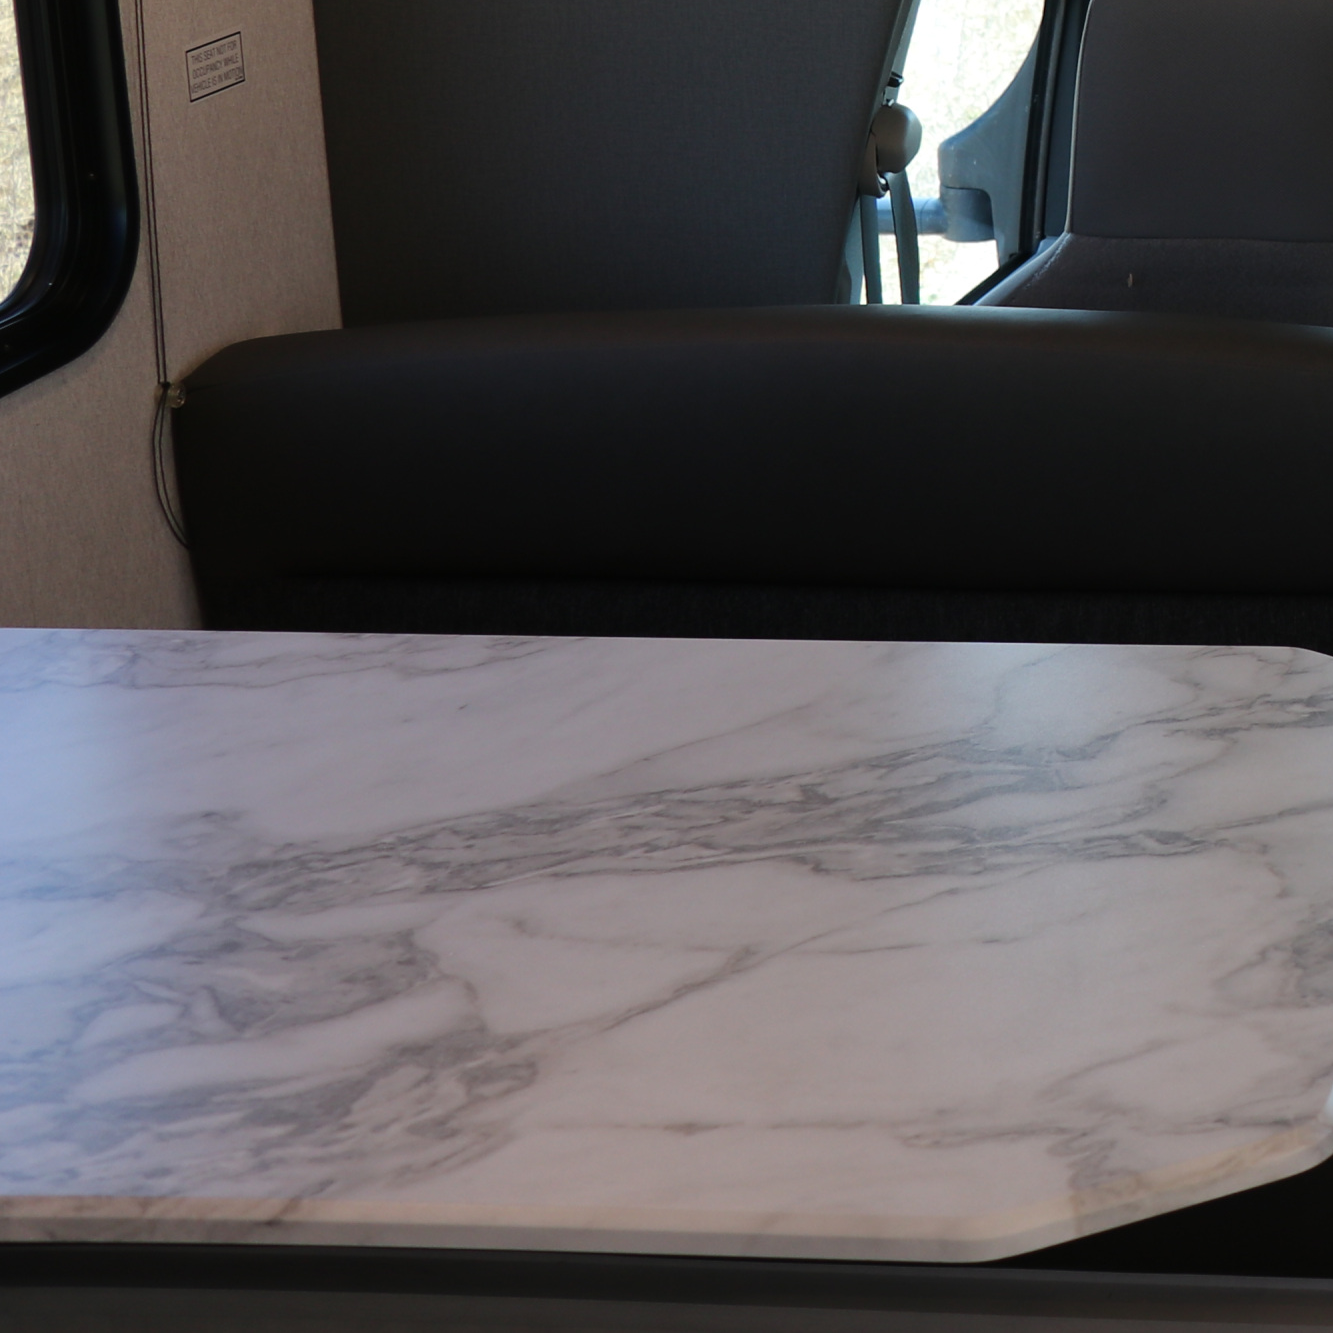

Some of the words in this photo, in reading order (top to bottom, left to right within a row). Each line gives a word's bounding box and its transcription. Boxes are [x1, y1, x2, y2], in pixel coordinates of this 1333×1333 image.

[191, 52, 203, 64] THIS
[203, 47, 216, 61] SEAT
[216, 44, 227, 56] NOT
[227, 40, 237, 51] FOR
[192, 60, 222, 80] OCCUPANCY
[223, 53, 239, 67] WHILE
[191, 77, 211, 94] VEHICLE
[211, 76, 217, 86] IS
[217, 74, 223, 84] IN
